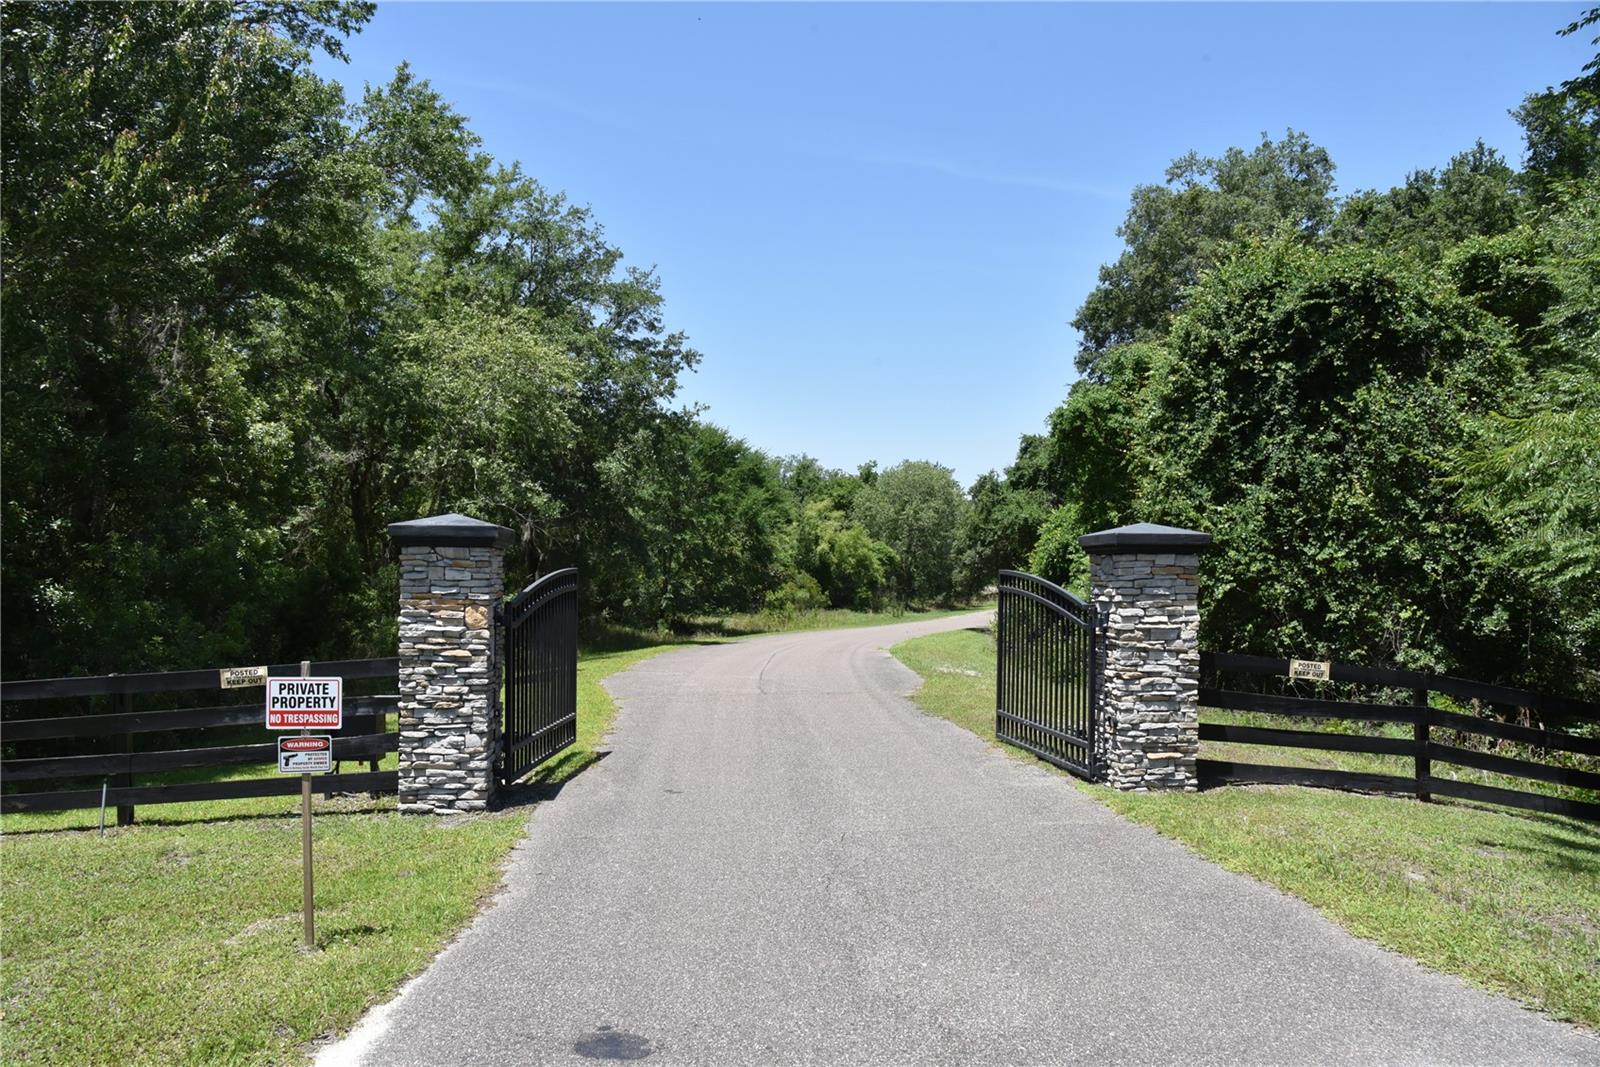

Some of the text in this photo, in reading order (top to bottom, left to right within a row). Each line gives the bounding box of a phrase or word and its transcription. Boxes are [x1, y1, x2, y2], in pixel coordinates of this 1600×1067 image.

[1298, 662, 1322, 670] POSTED
[230, 669, 259, 677] POSTED
[279, 683, 330, 695] PRIVATE
[271, 696, 336, 709] PROPERTY
[270, 713, 338, 724] NO TRESPASSING
